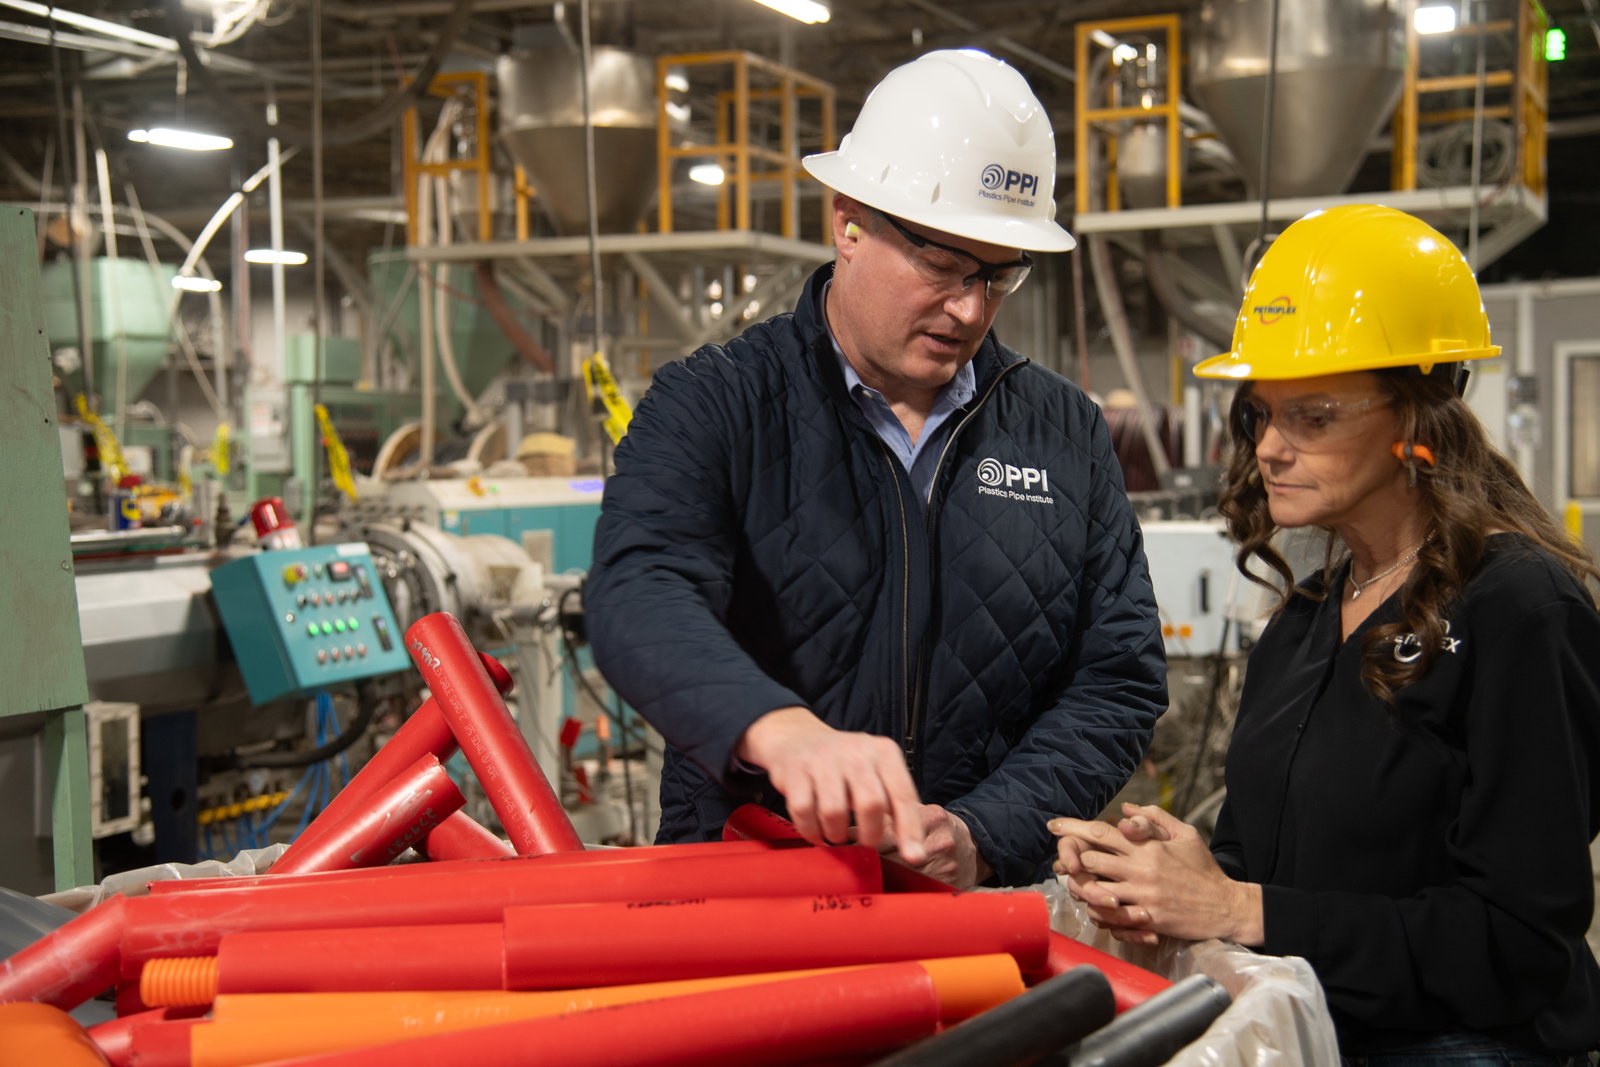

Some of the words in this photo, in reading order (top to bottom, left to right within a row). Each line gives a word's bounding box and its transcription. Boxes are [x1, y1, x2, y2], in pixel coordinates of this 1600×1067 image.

[1004, 170, 1038, 196] PPI
[979, 190, 1002, 201] Plastics
[1003, 194, 1017, 203] Pipe
[1017, 198, 1036, 207] Institute
[1254, 306, 1296, 315] PETROFLEX
[1005, 464, 1048, 491] PPI
[978, 485, 1007, 498] Plastics
[1008, 490, 1025, 501] Pipe
[1026, 493, 1054, 504] Institute
